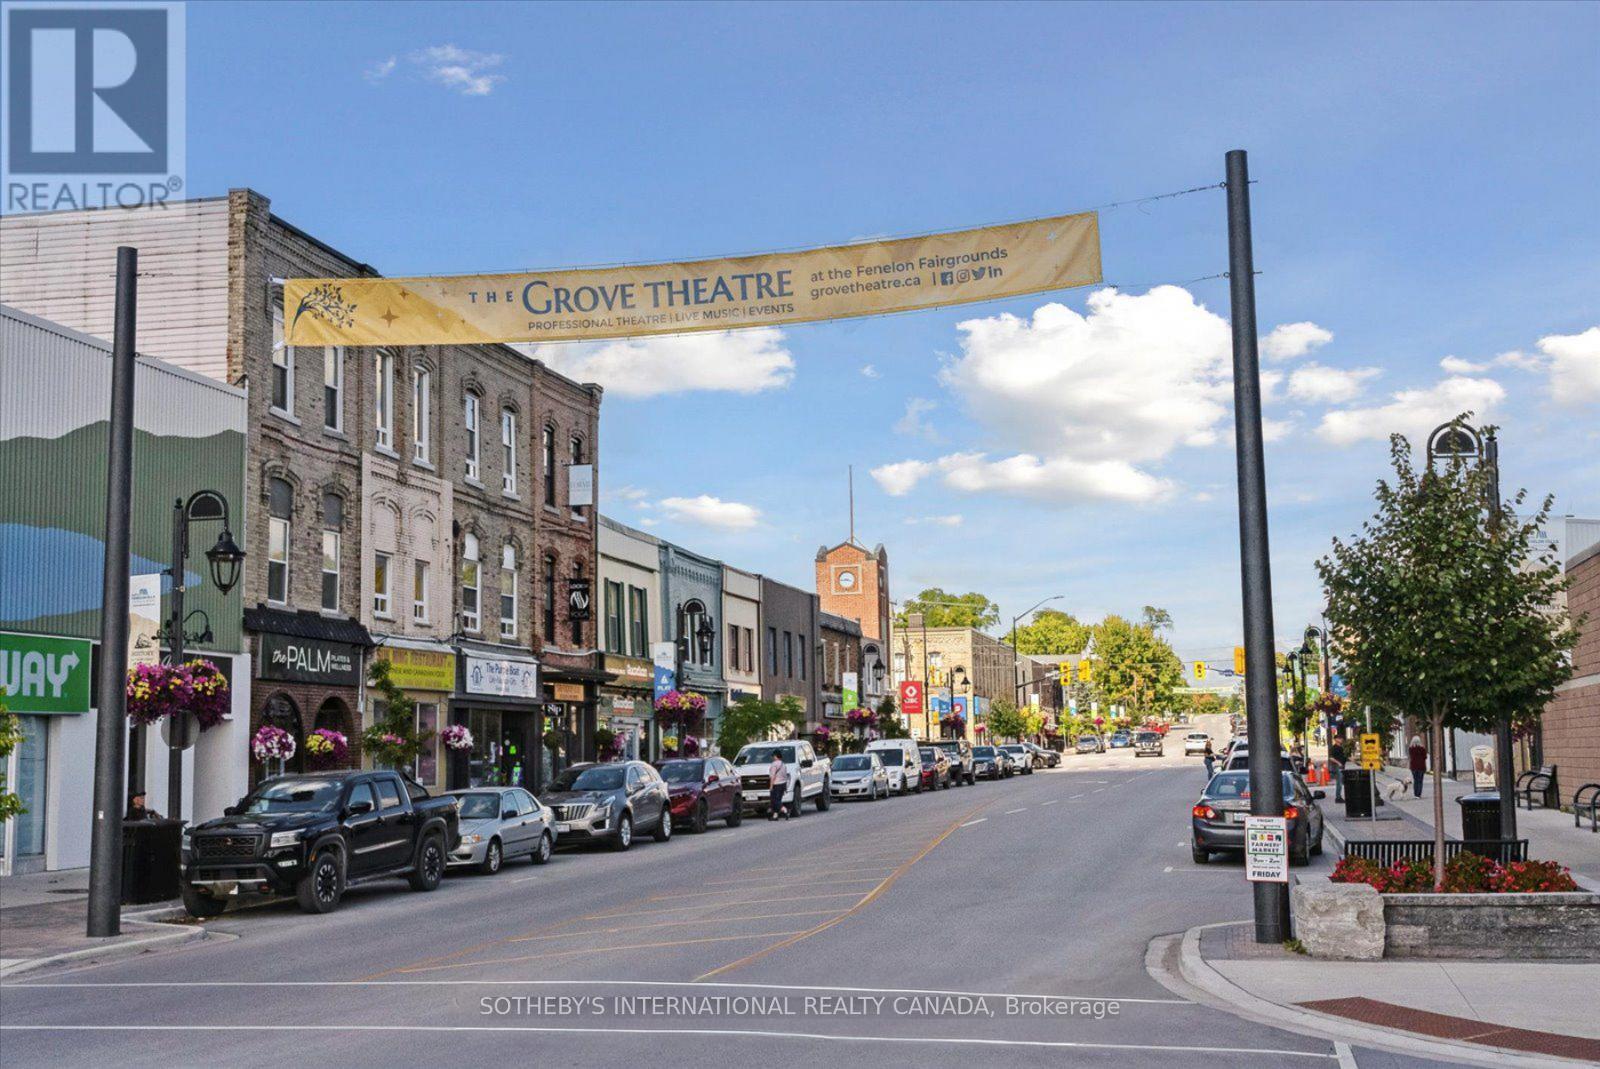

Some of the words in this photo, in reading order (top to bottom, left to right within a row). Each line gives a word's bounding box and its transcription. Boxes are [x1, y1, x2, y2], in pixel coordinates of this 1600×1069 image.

[810, 270, 824, 282] at
[828, 267, 852, 280] the
[856, 260, 915, 277] Fenelon
[919, 247, 1008, 269] Fairgrounds
[469, 291, 514, 304] THE
[522, 280, 635, 315] GROVE
[643, 270, 794, 308] THEATRE
[810, 275, 921, 300] grovetheatre.ca
[528, 316, 613, 331] PROFESSIONAL
[616, 313, 667, 327] THEATRE
[675, 311, 700, 323] LIVE
[703, 307, 740, 320] MUSIC
[749, 303, 794, 317] EVENTS
[272, 649, 287, 663] the
[287, 645, 331, 673] PALM
[1252, 870, 1281, 878] FRIDAY
